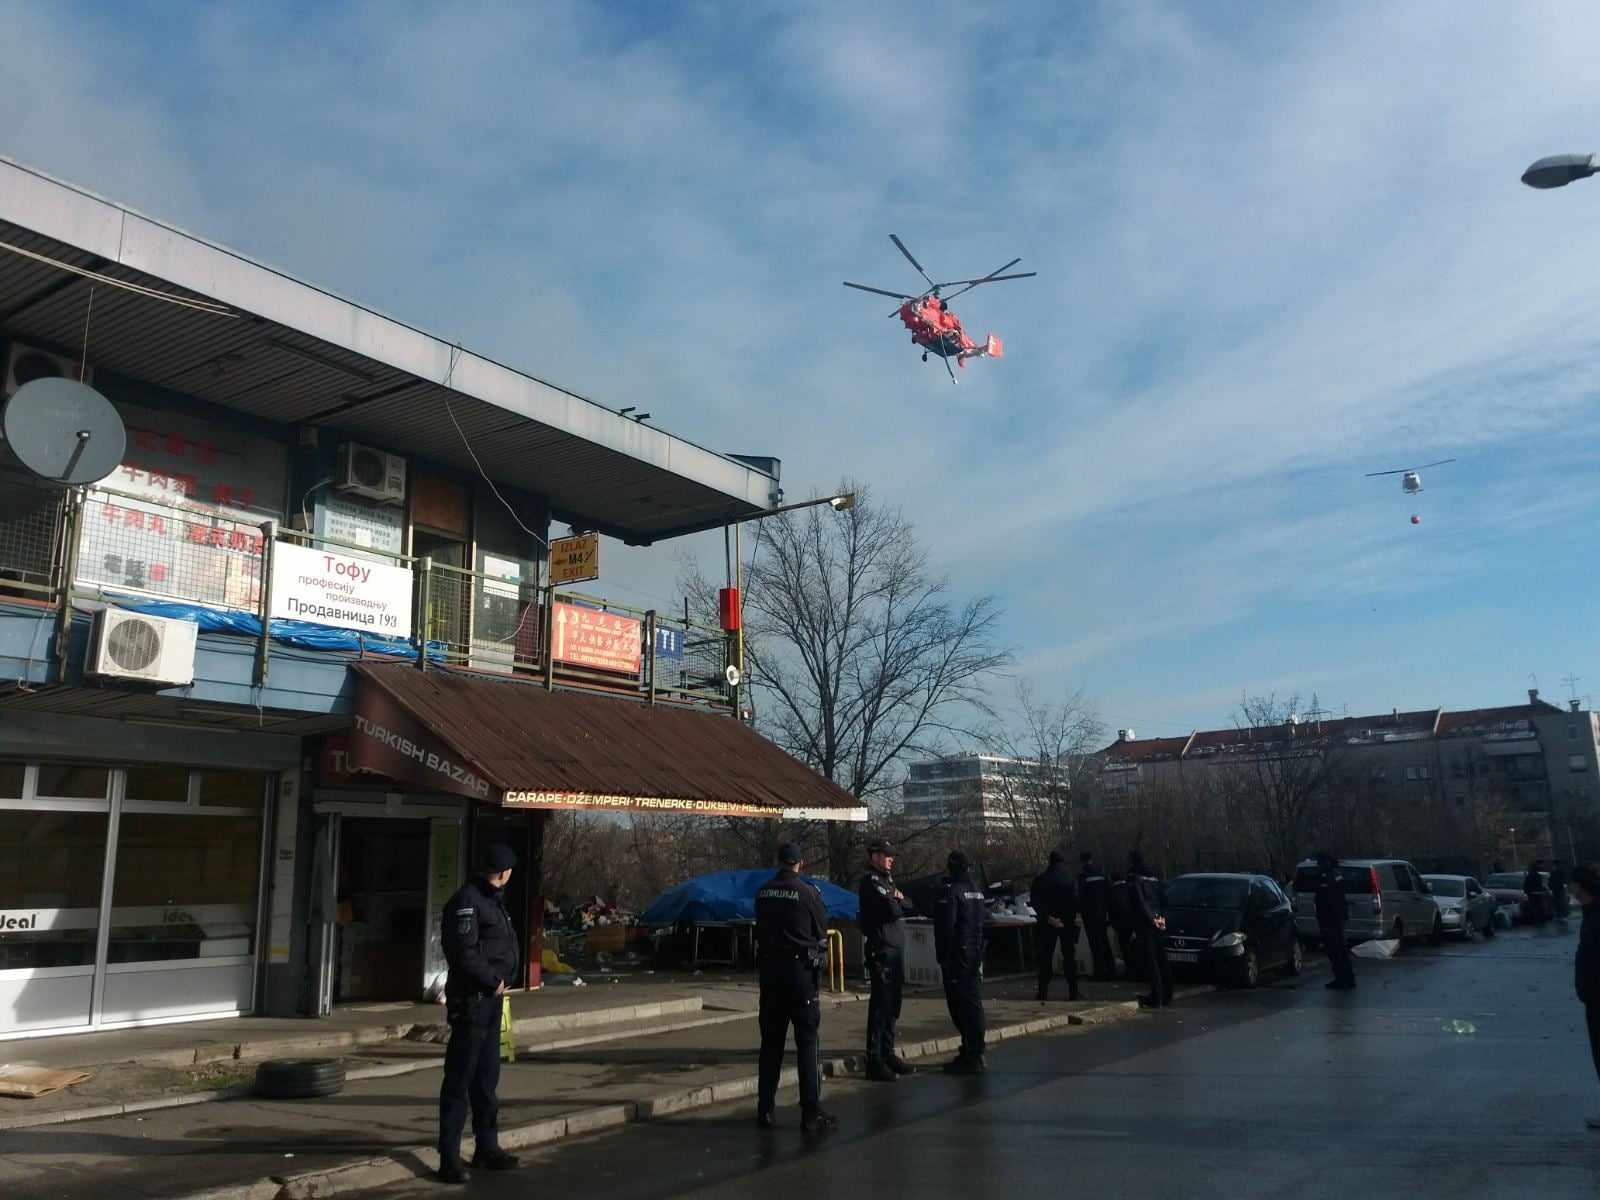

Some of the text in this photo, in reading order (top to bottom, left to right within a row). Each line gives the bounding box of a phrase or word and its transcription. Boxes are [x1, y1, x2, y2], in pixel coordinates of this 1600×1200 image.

[323, 555, 371, 583] Тофу
[563, 565, 583, 577] EXIT
[298, 575, 355, 594] професију
[288, 597, 375, 625] Продавница
[326, 591, 387, 611] производњу
[354, 714, 490, 796] TURKISH BAZAR
